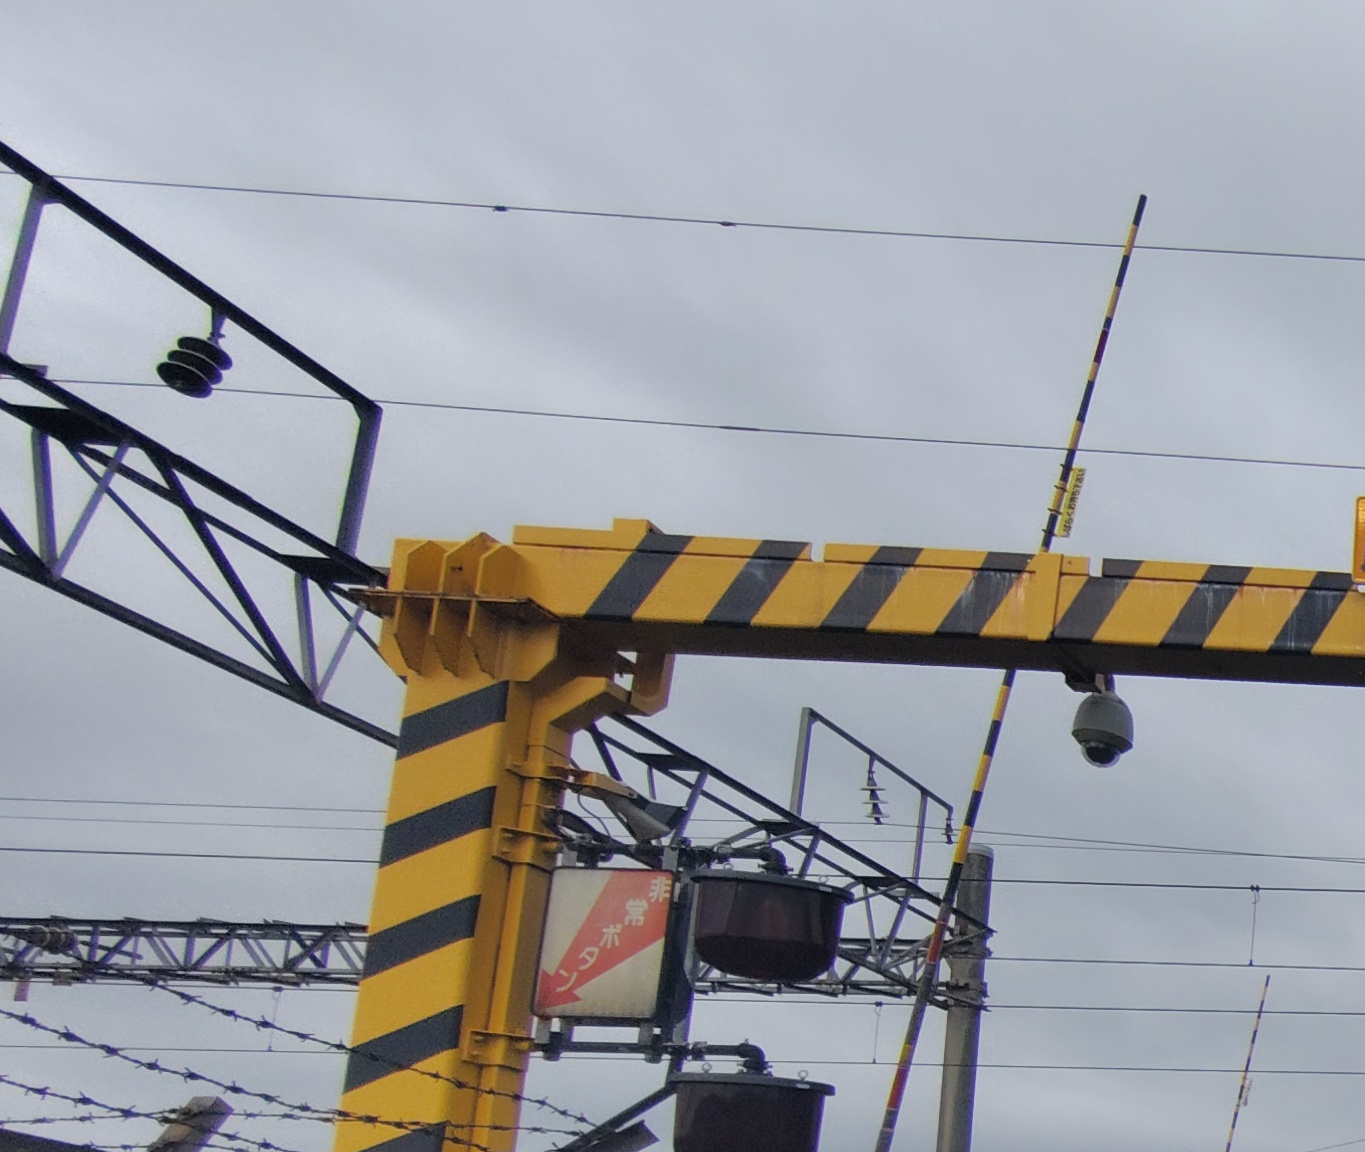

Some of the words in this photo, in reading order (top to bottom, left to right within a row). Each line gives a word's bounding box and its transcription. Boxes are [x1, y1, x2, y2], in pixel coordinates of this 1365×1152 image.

[555, 875, 673, 993] 非常ボタン
